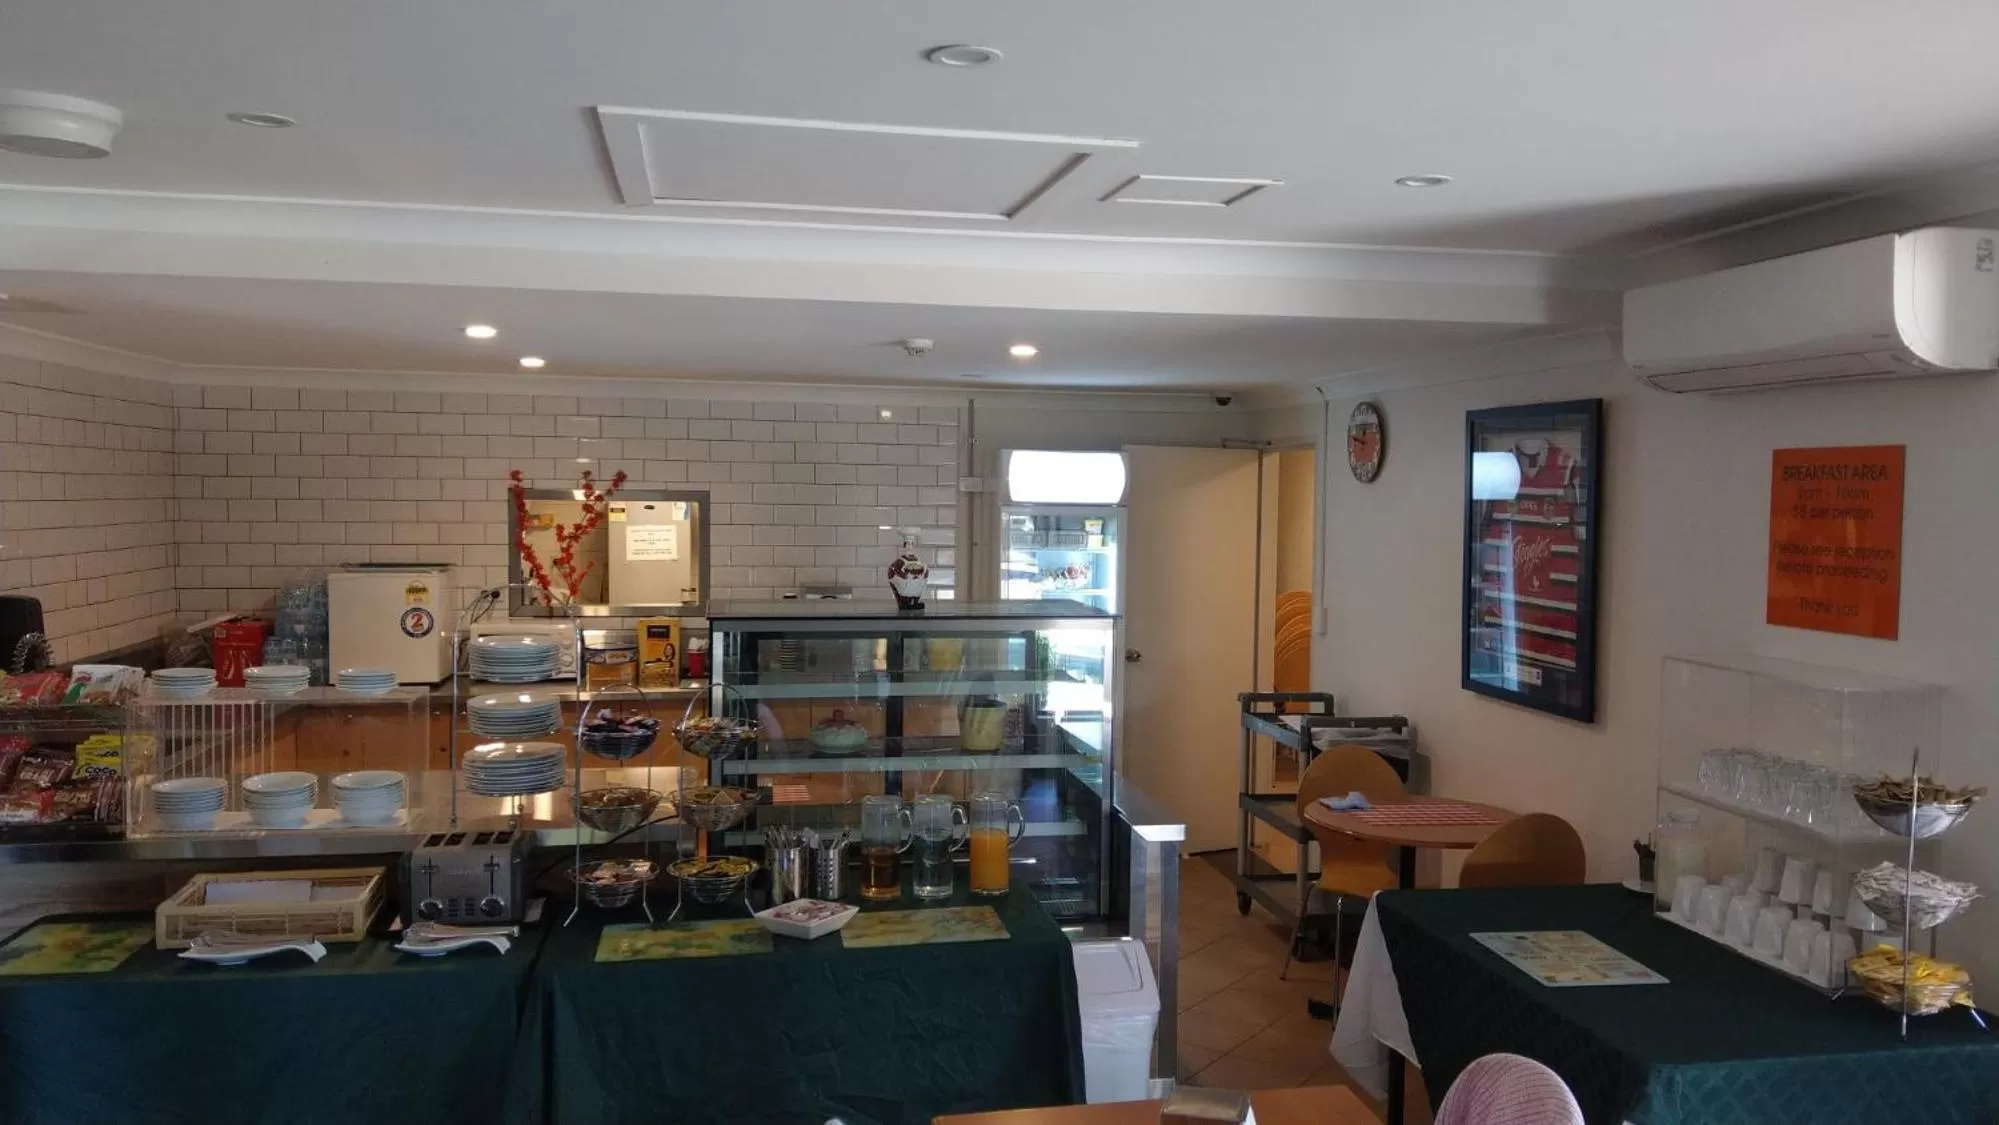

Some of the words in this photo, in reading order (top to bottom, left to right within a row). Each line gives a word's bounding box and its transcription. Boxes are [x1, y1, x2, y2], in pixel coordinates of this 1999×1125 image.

[1782, 464, 1848, 481] BREAKFAST
[1852, 464, 1888, 480] AREA
[1834, 546, 1895, 562] reception
[1816, 564, 1888, 585] proceeding
[1799, 597, 1833, 613] Thank
